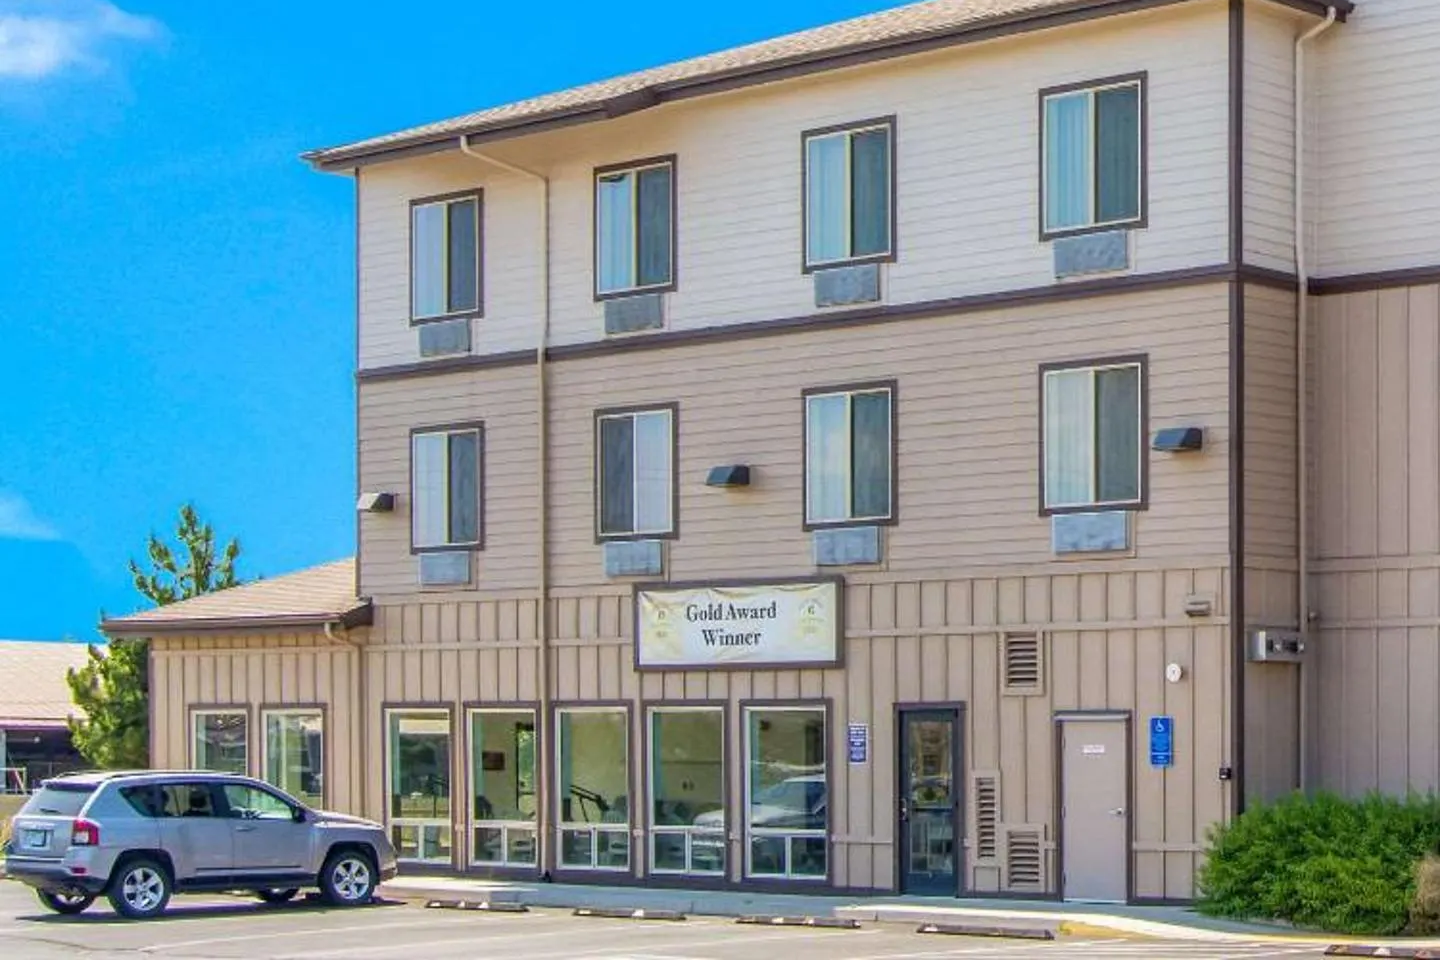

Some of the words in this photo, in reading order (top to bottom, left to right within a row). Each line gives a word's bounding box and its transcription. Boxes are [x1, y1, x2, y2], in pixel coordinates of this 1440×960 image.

[686, 603, 723, 622] Gold
[726, 601, 777, 620] Award
[702, 628, 762, 647] Winner
